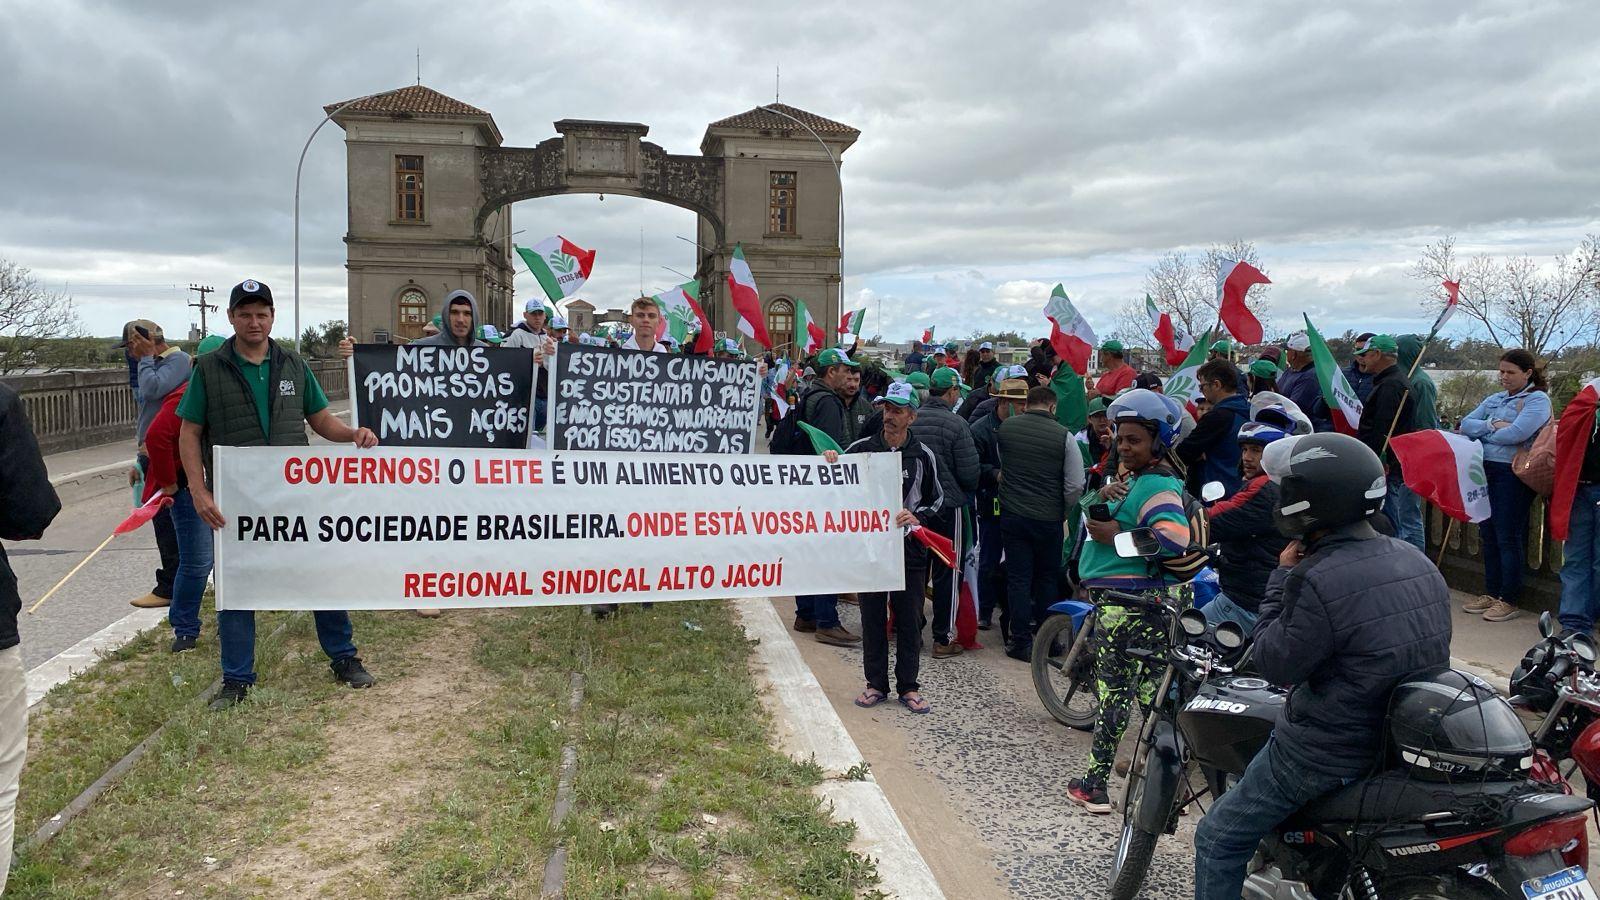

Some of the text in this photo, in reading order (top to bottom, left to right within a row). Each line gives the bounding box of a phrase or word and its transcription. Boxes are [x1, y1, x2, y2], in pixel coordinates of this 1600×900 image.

[396, 345, 489, 373] MENOS
[568, 351, 756, 388] ESTAMOS CANSADOS
[363, 371, 514, 403] PROMESSAS
[560, 378, 587, 399] DE
[592, 381, 693, 405] SUSTENTAR
[700, 383, 712, 406] O
[469, 400, 527, 443] AÇÕES
[556, 402, 568, 424] E
[569, 399, 601, 425] NÃO
[564, 425, 600, 450] POR
[284, 455, 860, 486] GOVERNOS! O LEITE É UM ALIMENTO QUE FAZ BEM
[238, 506, 890, 542] PARA SOCIEDADE BRASILEIRA. ONDE ESTÁ VOSSA AJUDA?
[404, 557, 783, 598] REGIONAL SINDICAL ALTO JACUÍ
[1183, 694, 1246, 713] YUMBO
[1387, 843, 1441, 857] YUMBO
